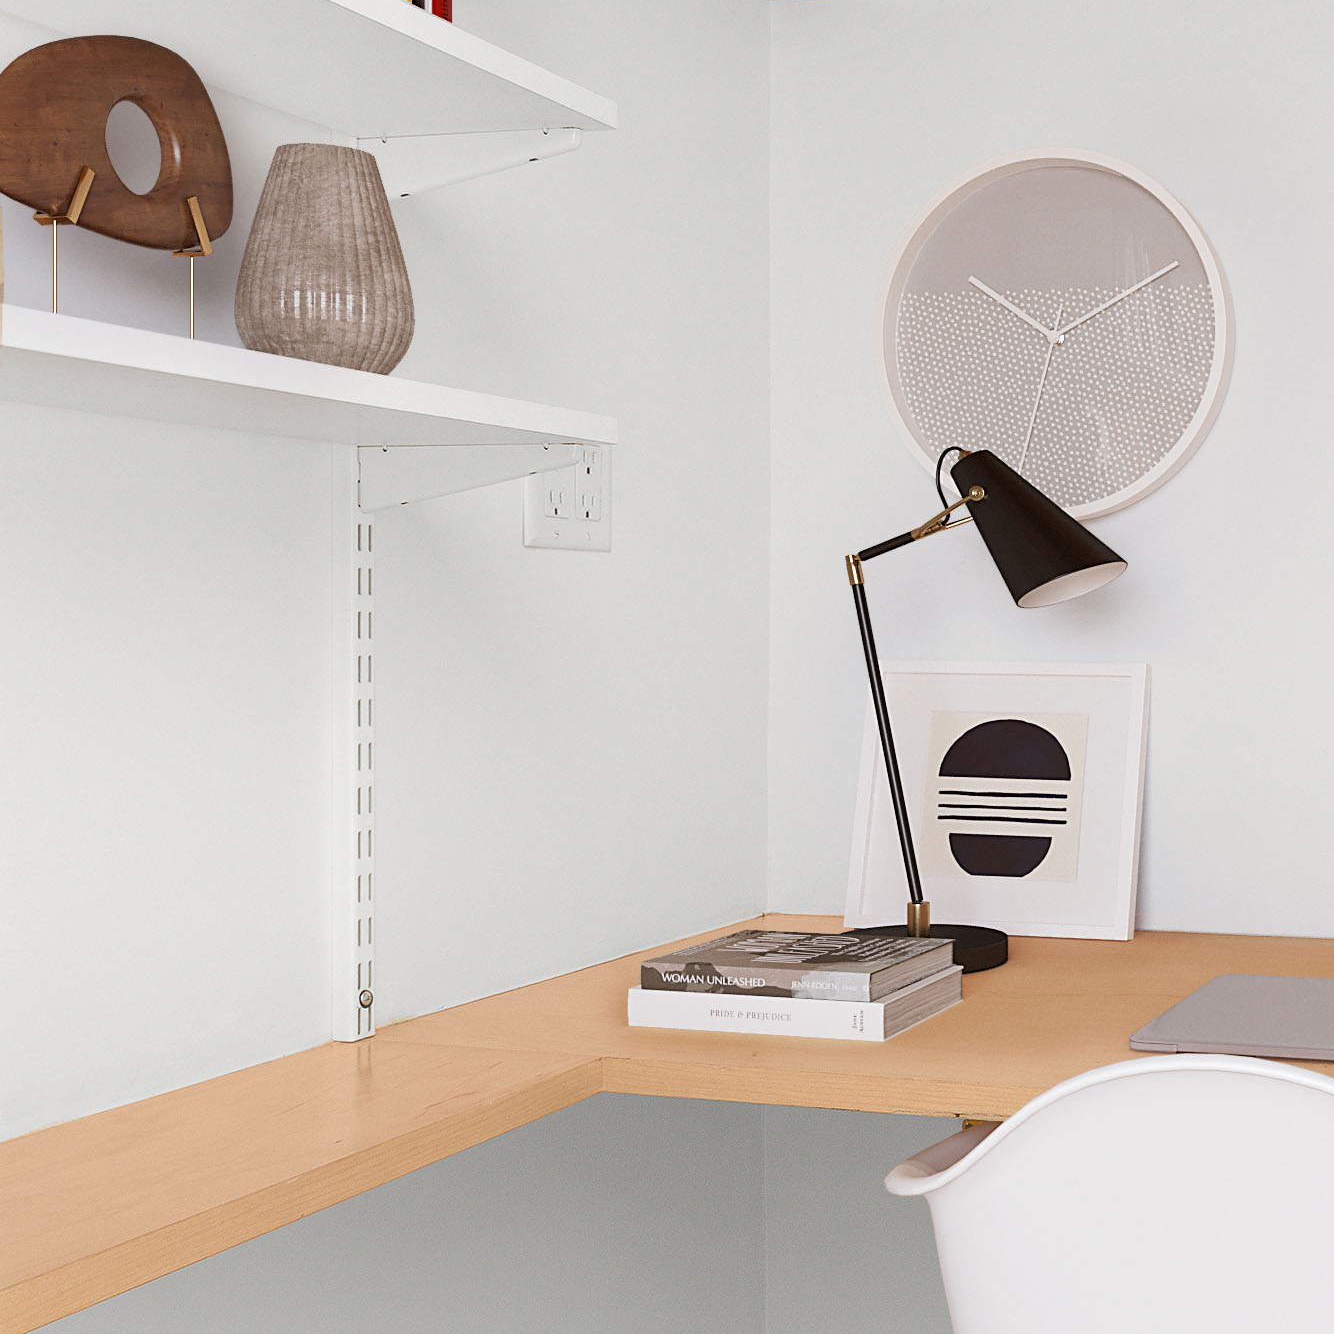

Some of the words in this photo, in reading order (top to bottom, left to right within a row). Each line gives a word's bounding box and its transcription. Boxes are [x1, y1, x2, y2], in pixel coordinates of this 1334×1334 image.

[661, 972, 705, 984] WOMAN
[707, 975, 766, 988] UNLEASHED
[710, 1009, 735, 1018] PRIDE
[746, 1011, 792, 1022] PREJUDICE
